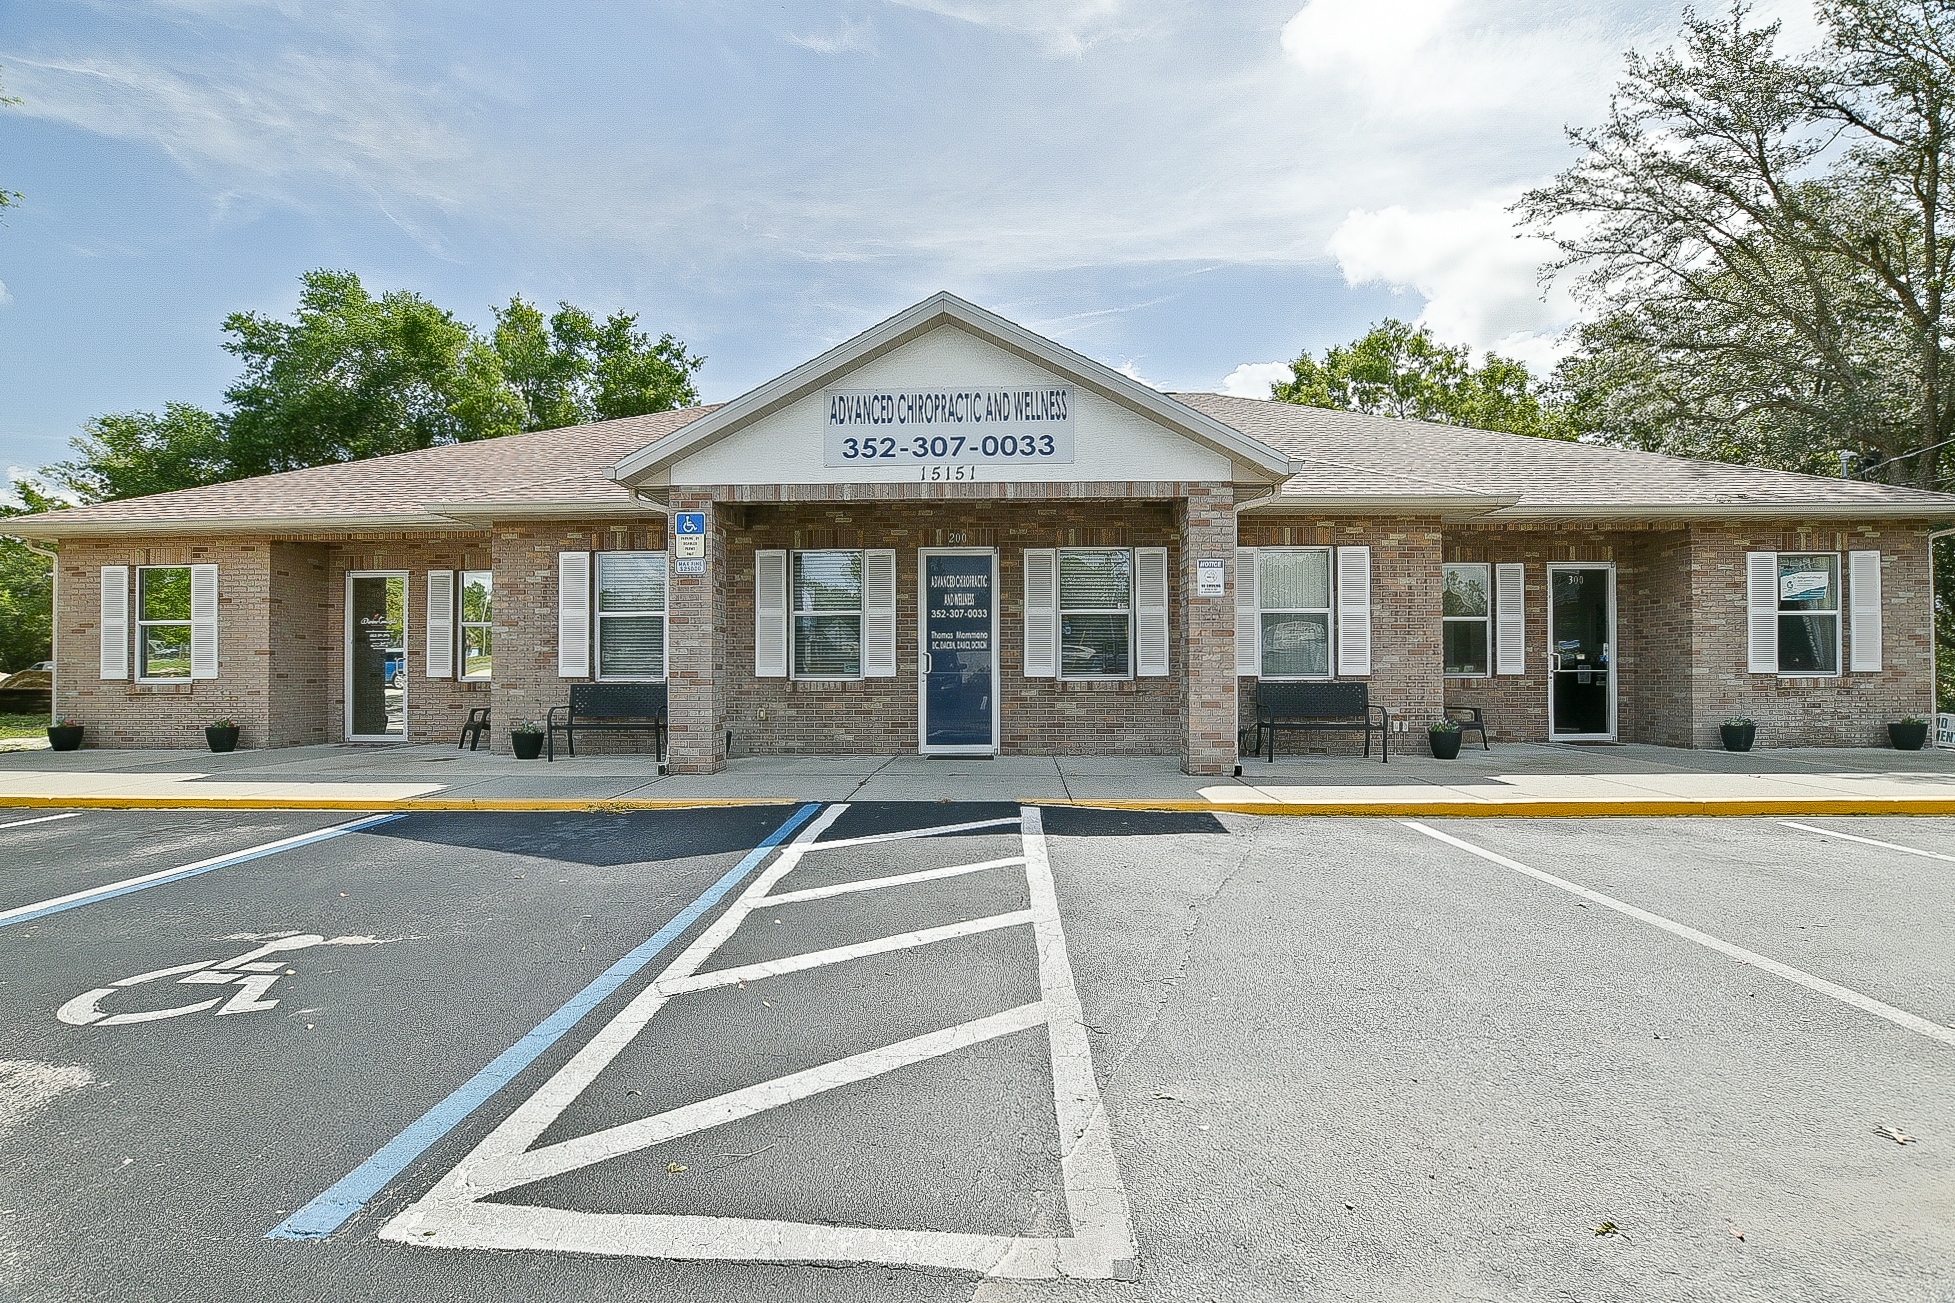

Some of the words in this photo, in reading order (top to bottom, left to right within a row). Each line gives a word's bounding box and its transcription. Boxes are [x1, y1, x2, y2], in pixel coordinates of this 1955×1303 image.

[829, 394, 894, 425] ADVANCED
[898, 392, 982, 424] CHIROPRACTIC
[985, 392, 1010, 423] AND
[1013, 390, 1068, 422] WELLNESS
[842, 434, 1055, 459] 352-307-0033
[920, 465, 976, 481] 15151
[948, 532, 967, 543] 200
[930, 575, 955, 588] ADVANCED
[955, 574, 988, 588] CHIROPRACTIC
[1568, 575, 1584, 585] 300
[943, 593, 954, 606] AND
[954, 593, 975, 606] WELLNESS
[931, 609, 988, 618] 352-307-0033
[931, 630, 954, 639] Thomas
